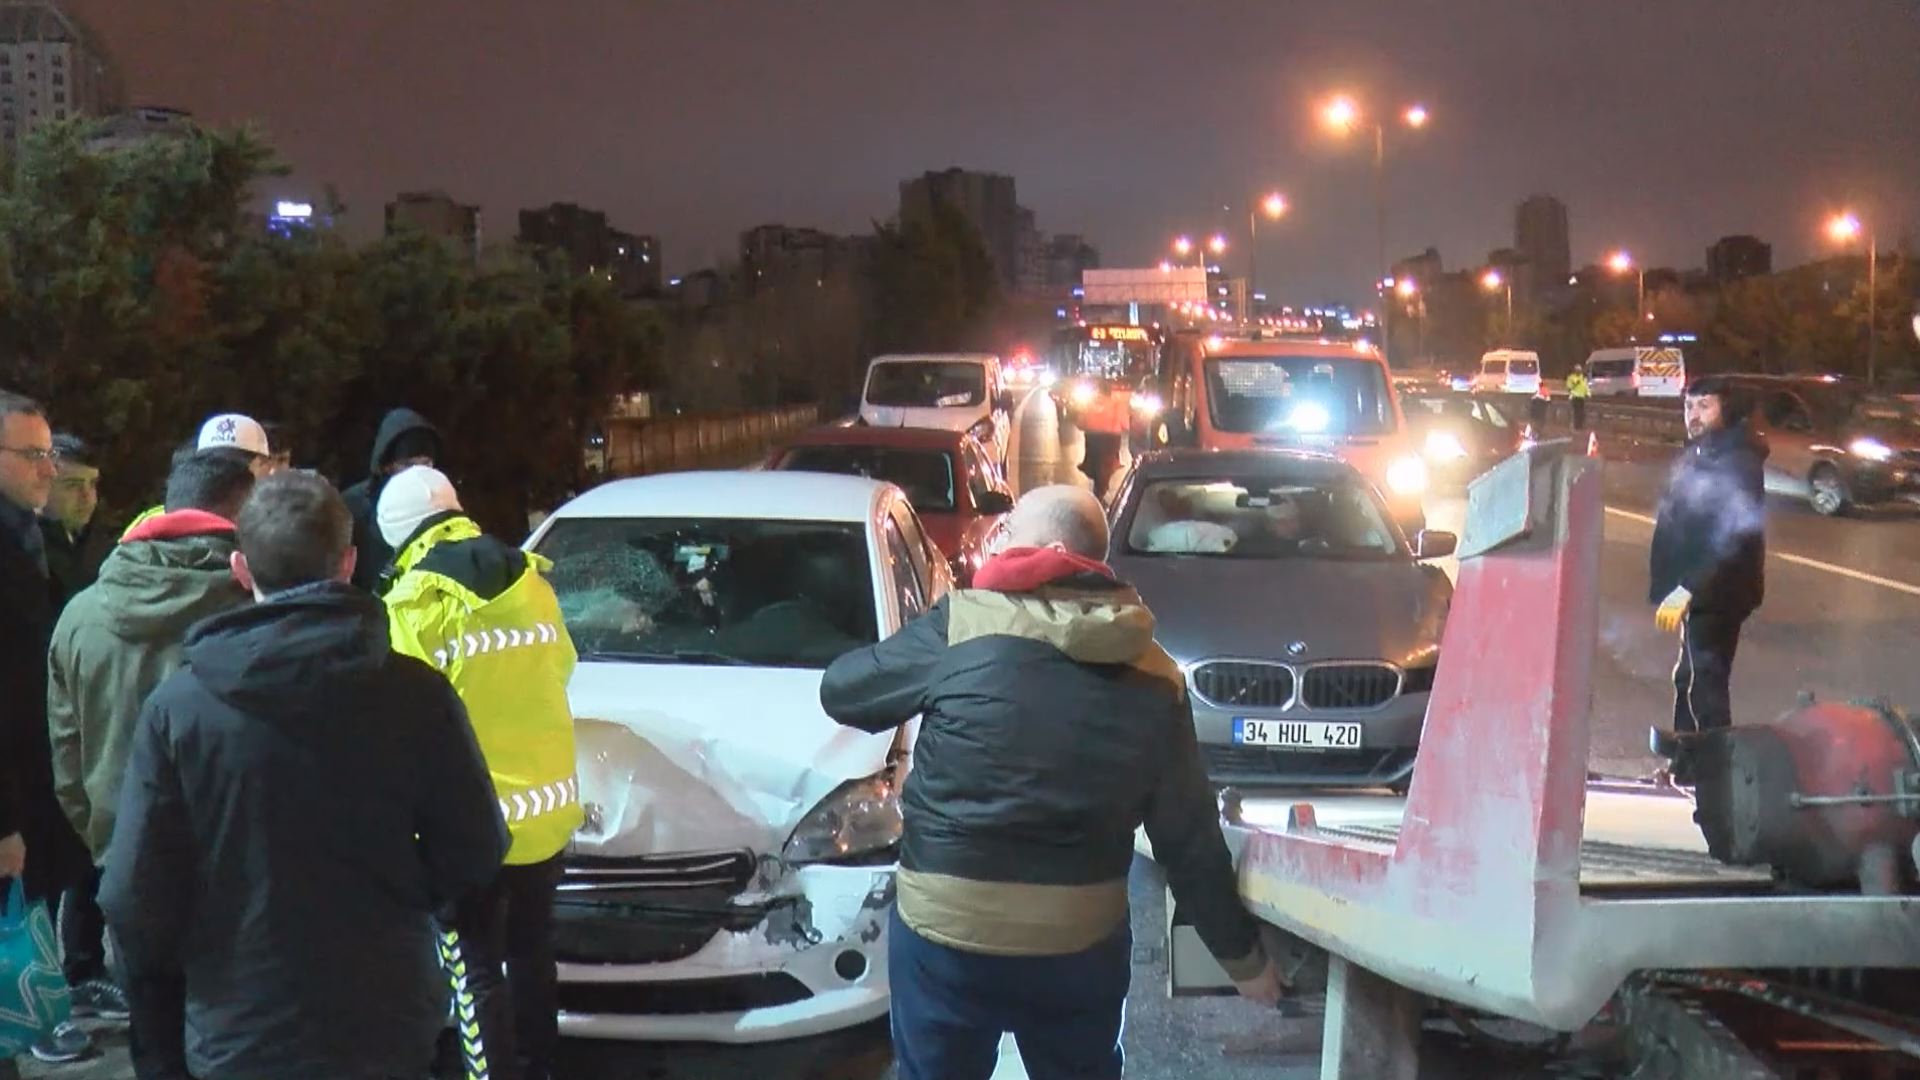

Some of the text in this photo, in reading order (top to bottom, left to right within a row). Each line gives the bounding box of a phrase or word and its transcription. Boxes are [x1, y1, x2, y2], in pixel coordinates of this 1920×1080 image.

[1245, 722, 1358, 745] 34 HUL 420
